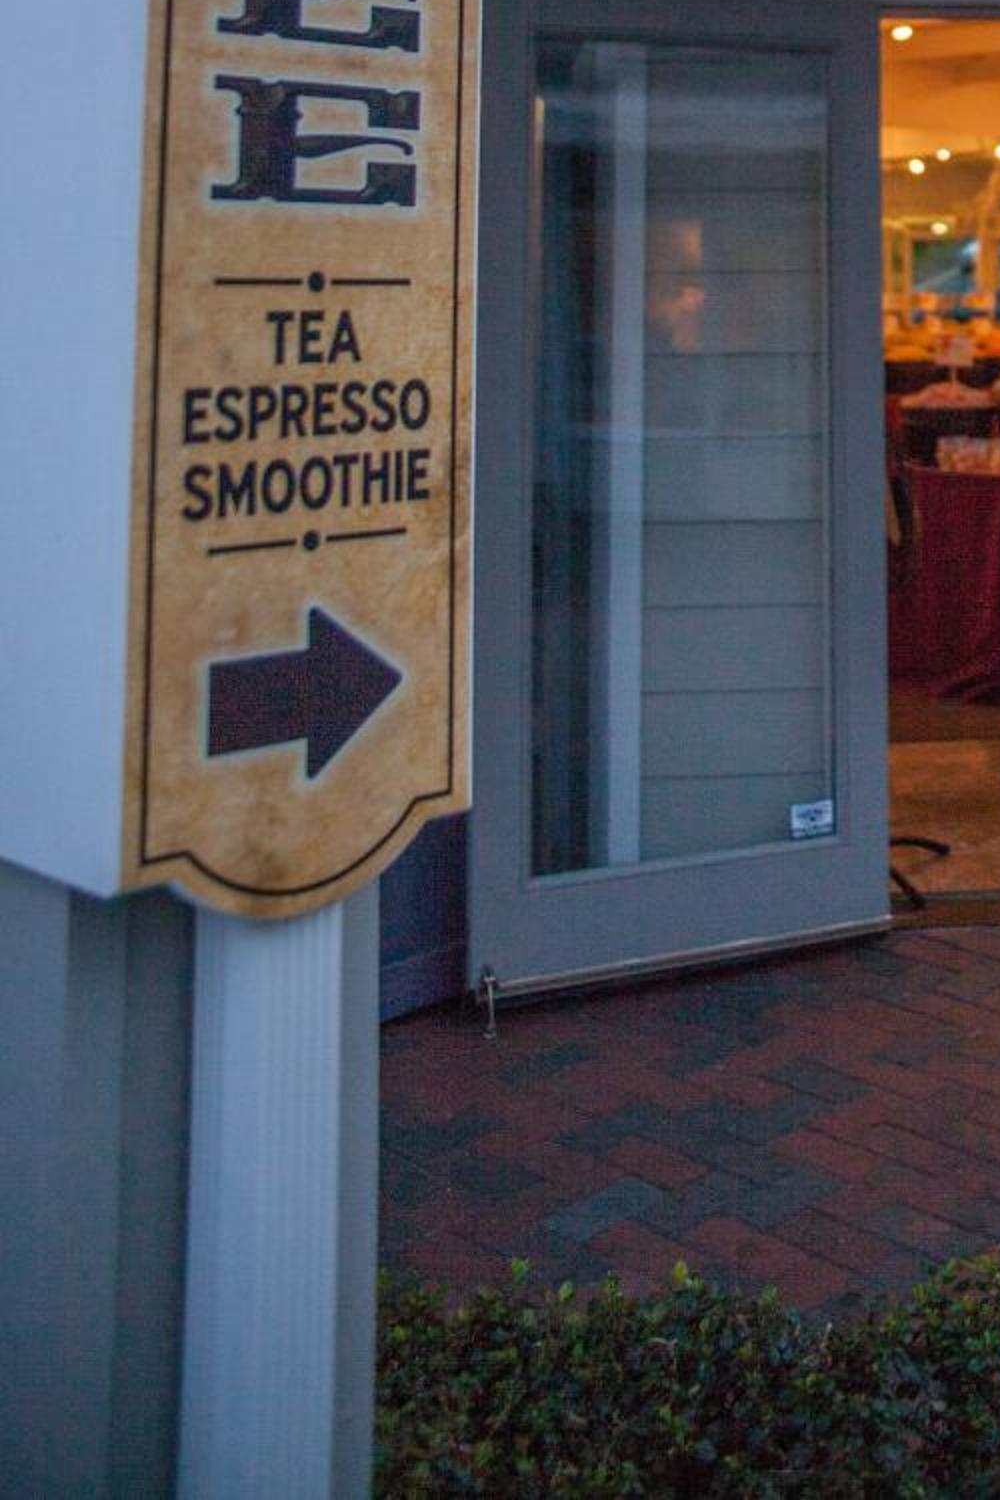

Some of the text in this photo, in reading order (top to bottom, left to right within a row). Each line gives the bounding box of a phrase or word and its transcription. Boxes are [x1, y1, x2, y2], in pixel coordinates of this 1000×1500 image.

[265, 309, 361, 365] TEA
[182, 378, 432, 444] ESPRESSO
[180, 449, 431, 522] SMOOTHIE
